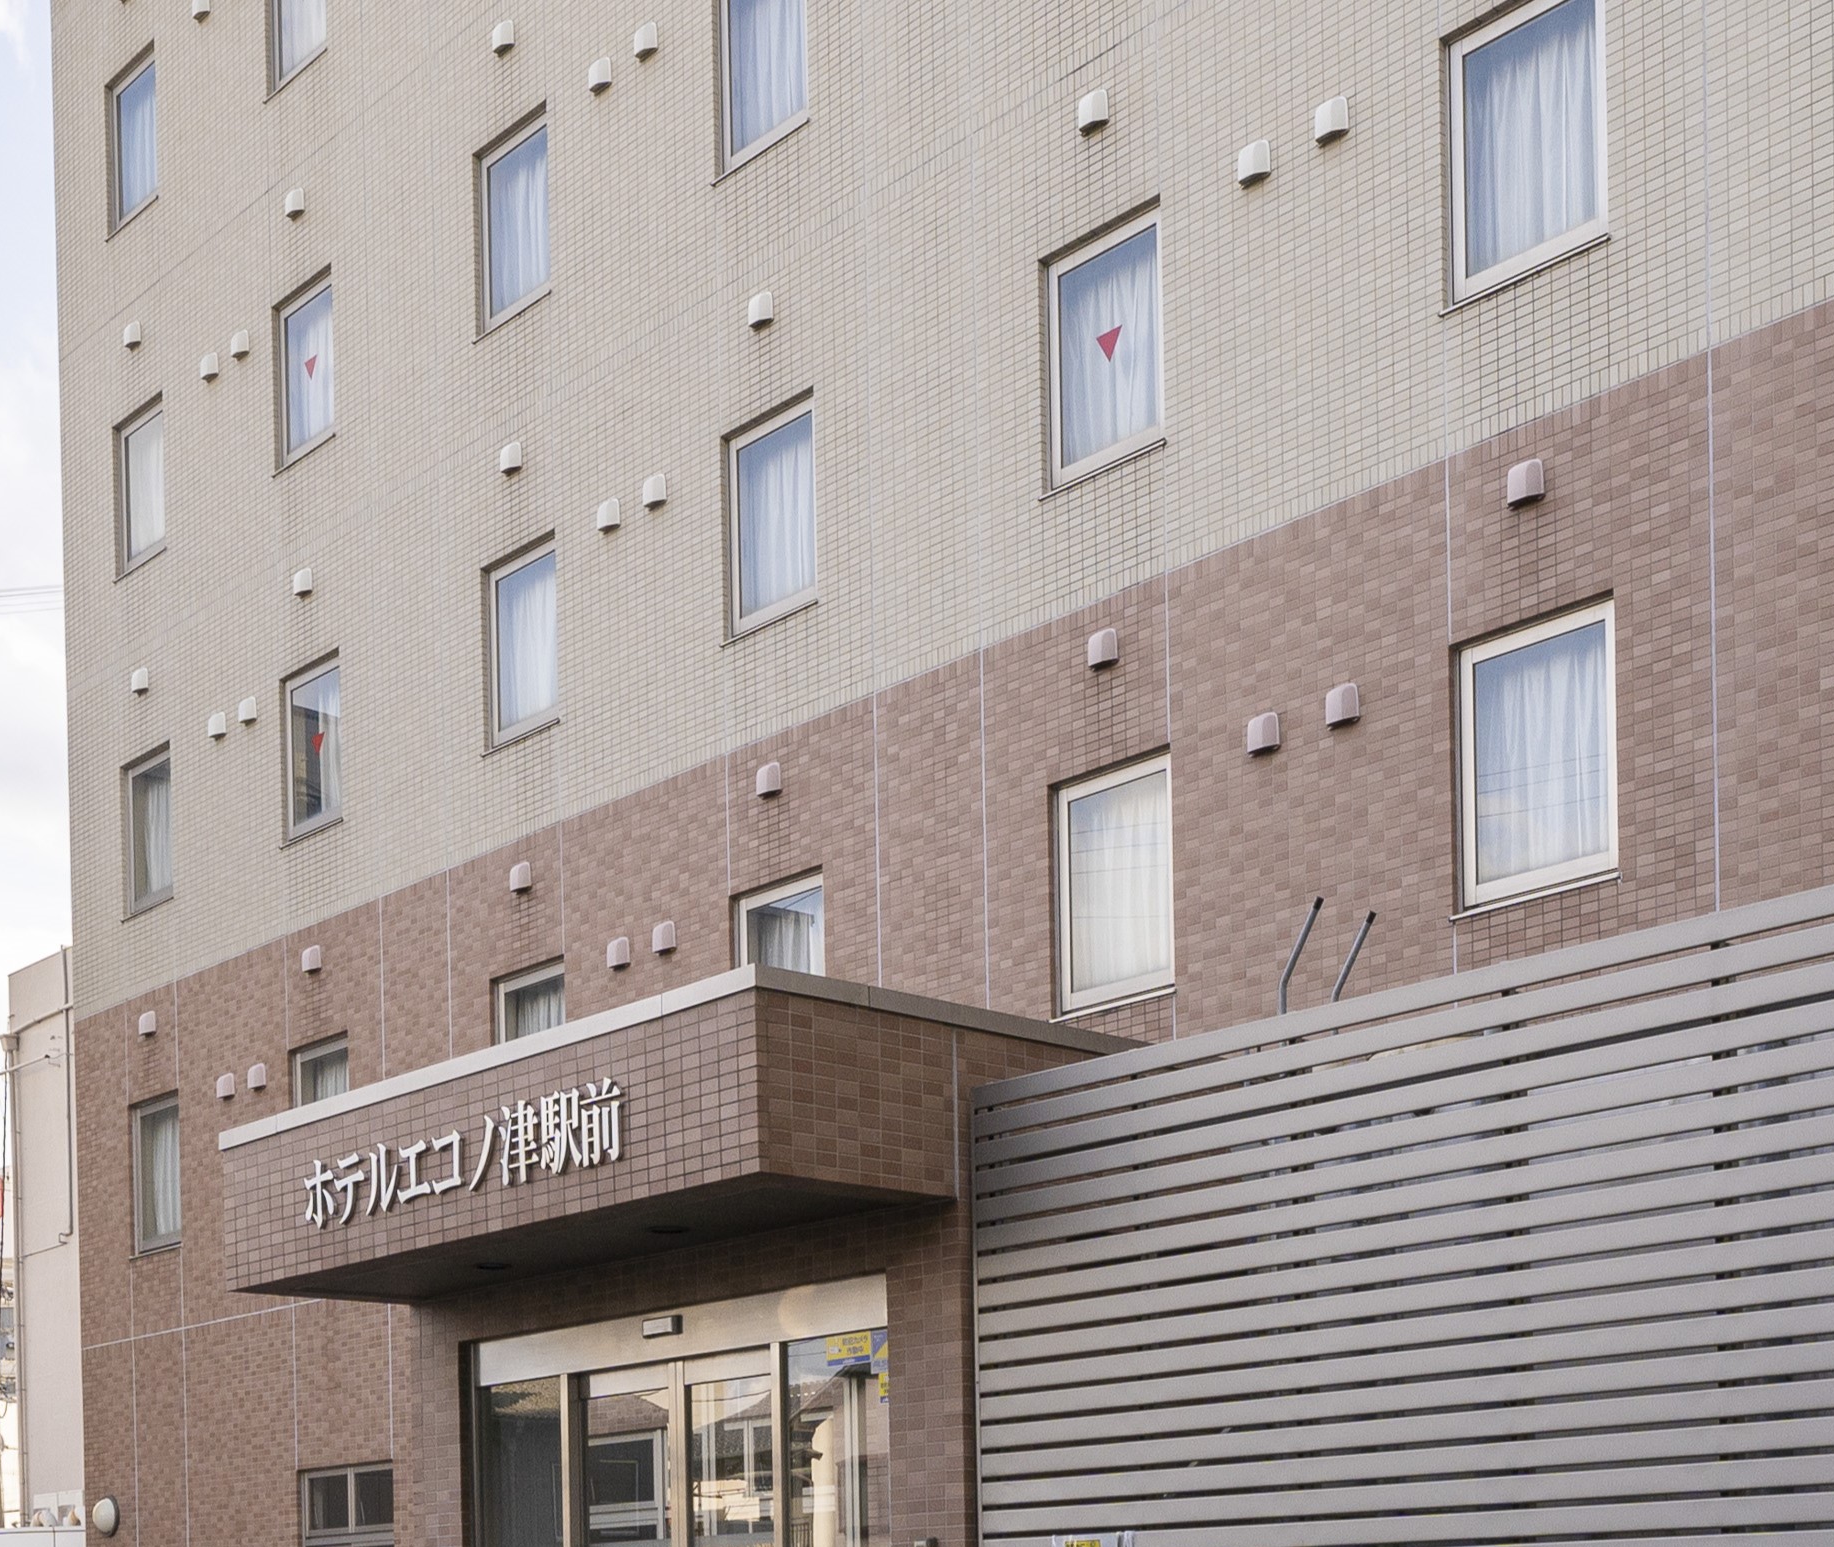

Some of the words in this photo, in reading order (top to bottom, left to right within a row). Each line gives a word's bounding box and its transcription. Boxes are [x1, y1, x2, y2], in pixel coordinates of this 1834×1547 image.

[303, 1076, 622, 1229] ホテルエコノ津駅前
